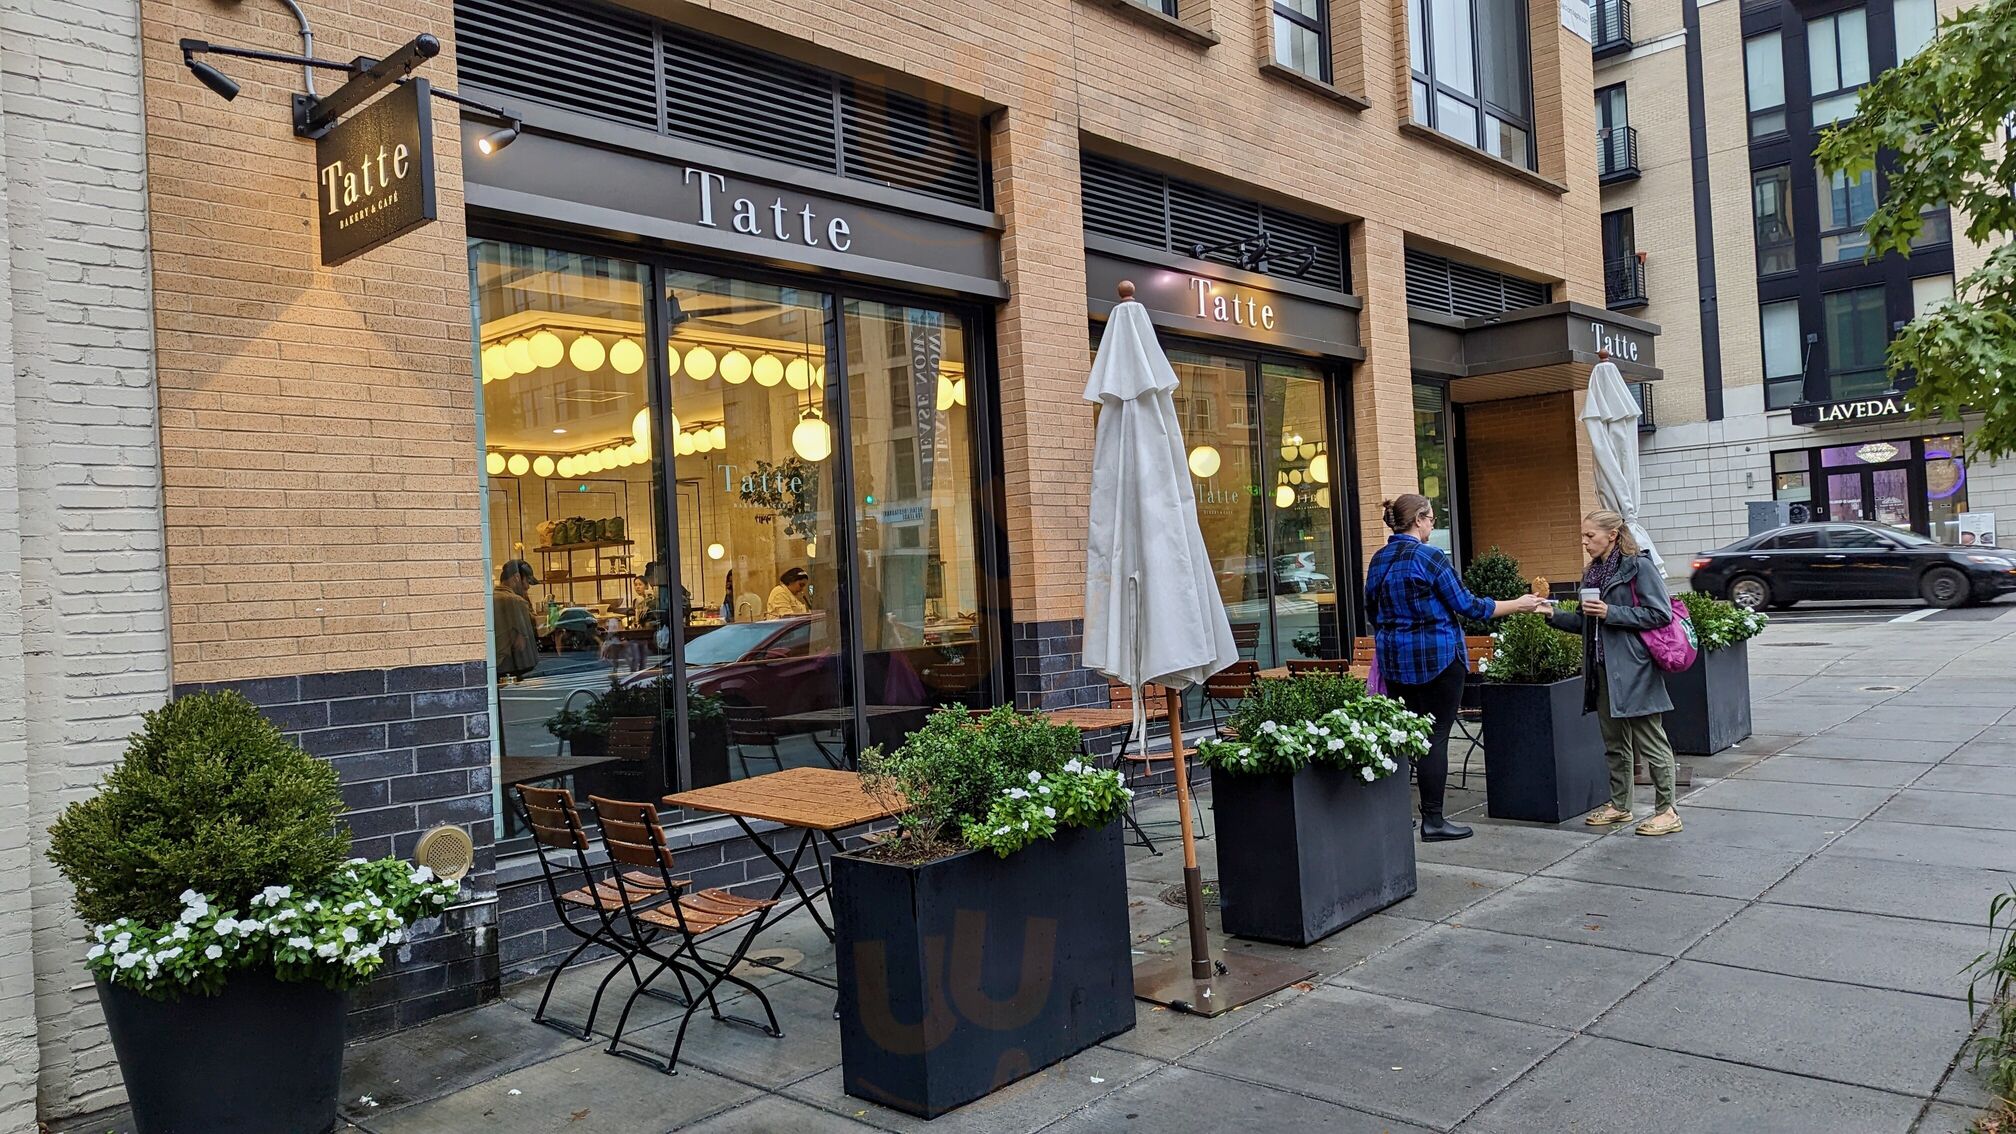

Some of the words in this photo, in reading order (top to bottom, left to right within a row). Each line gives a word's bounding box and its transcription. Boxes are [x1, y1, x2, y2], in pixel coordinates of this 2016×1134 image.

[321, 143, 409, 216] Tatte
[339, 207, 369, 230] BAKERY
[370, 204, 376, 214] &
[683, 166, 851, 252] Tatte
[1190, 277, 1275, 331] Tatte
[1591, 322, 1638, 362] Tatte
[1818, 398, 1899, 422] LAVEDA
[717, 463, 803, 494] Tatte
[1194, 483, 1240, 504] Tatte
